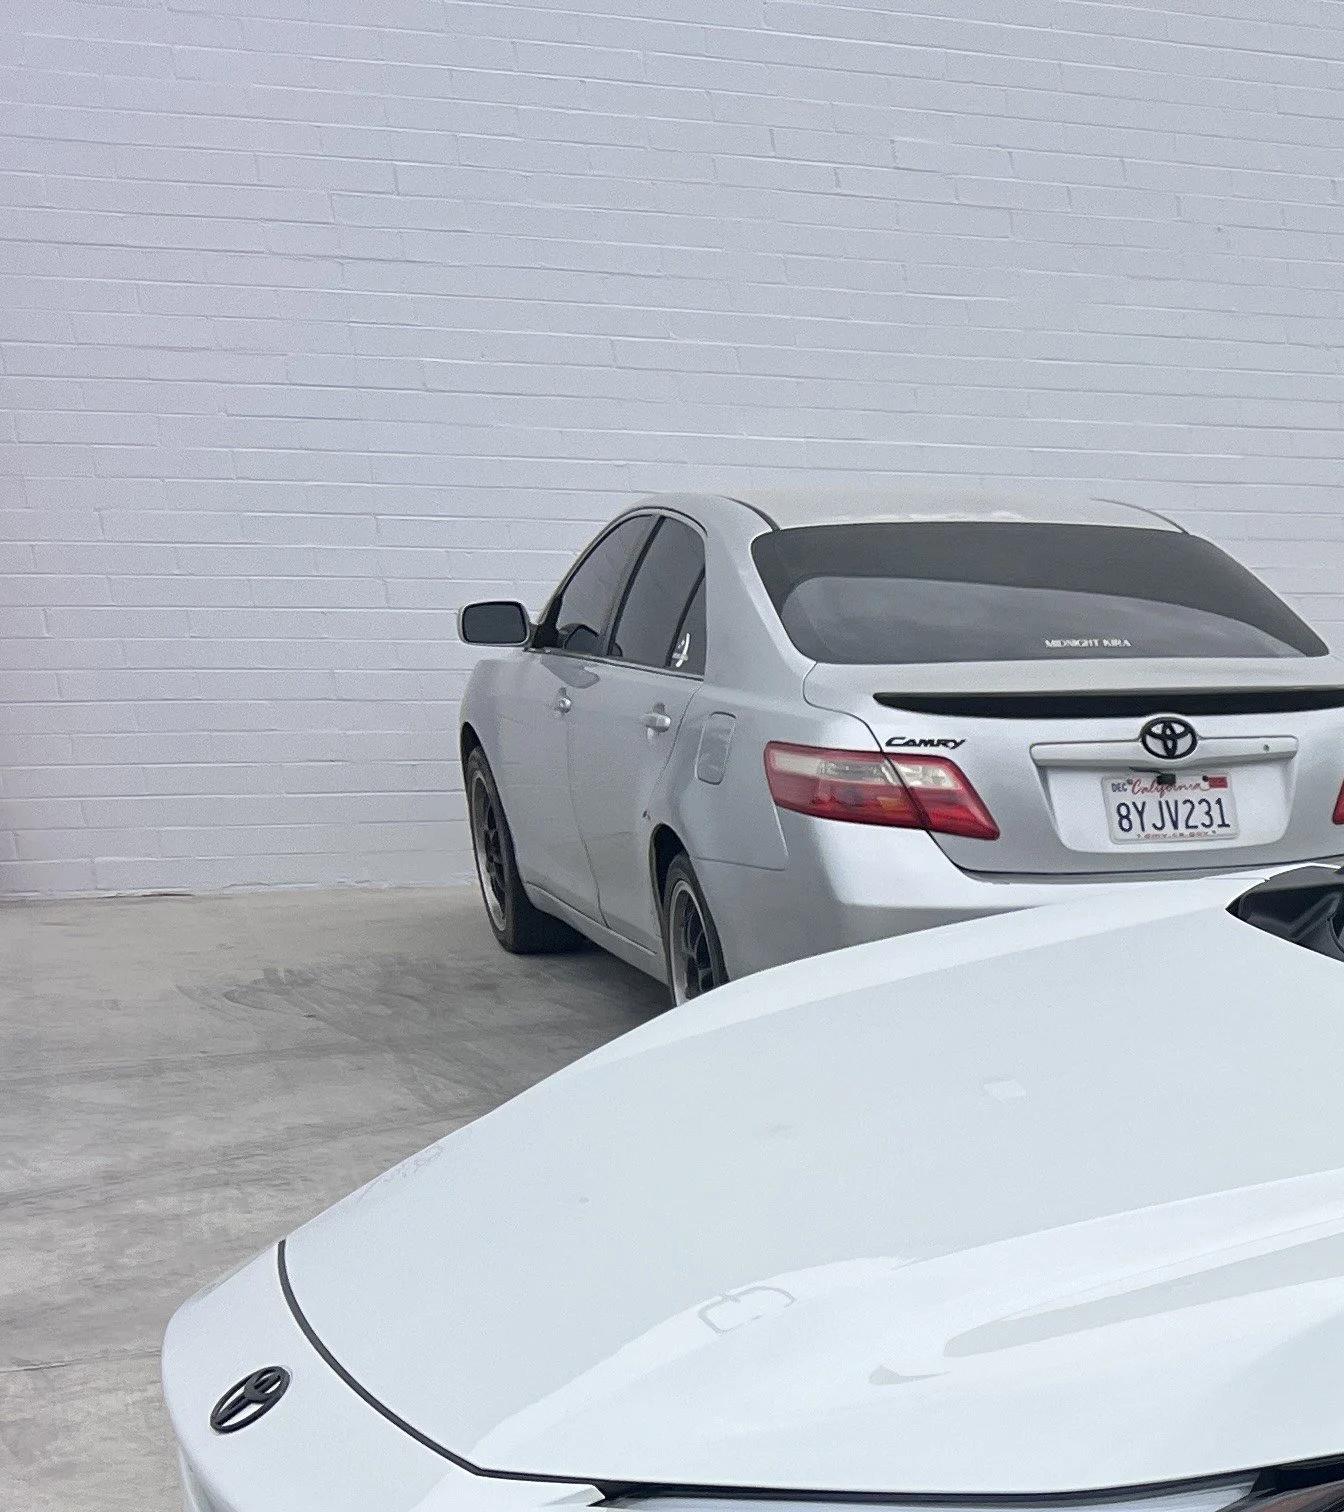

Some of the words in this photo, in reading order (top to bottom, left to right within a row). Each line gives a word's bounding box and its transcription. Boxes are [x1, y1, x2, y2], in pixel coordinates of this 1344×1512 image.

[1044, 638, 1099, 648] MIDNIGHT
[1111, 782, 1127, 793] DEC
[1116, 797, 1231, 833] 8YJV231
